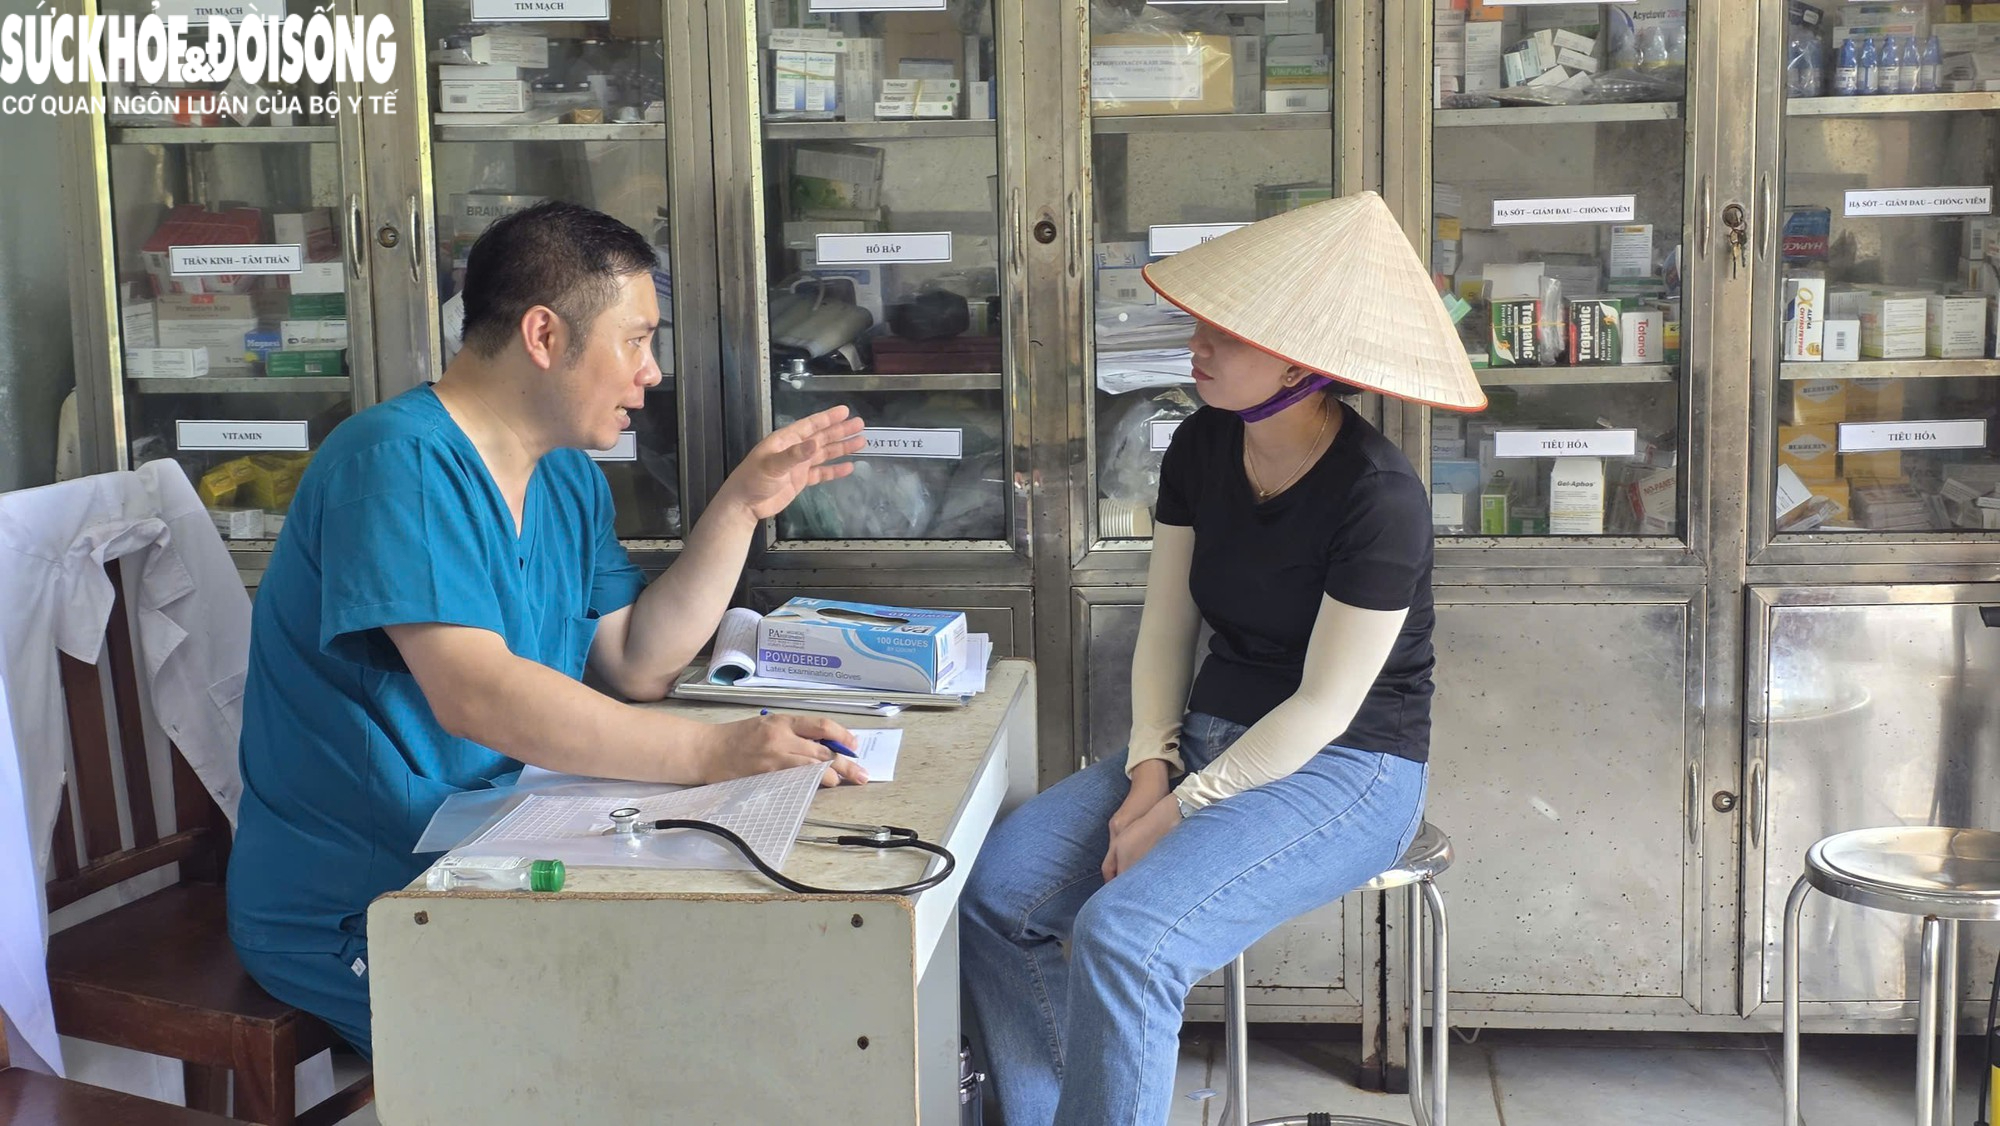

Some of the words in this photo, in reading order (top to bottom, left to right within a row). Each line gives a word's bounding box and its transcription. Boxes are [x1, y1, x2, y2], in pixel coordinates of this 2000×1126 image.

[195, 7, 213, 16] TIM
[515, 2, 532, 10] TIM
[535, 2, 565, 11] MẠCH
[1849, 201, 1861, 210] HẠ
[1497, 209, 1508, 218] HẠ
[210, 257, 233, 265] KINH
[241, 254, 262, 264] TÂM
[1519, 303, 1535, 359] Trapavic
[1578, 305, 1594, 361] Trapavic
[222, 432, 262, 440] VITAMIN
[1888, 431, 1911, 441] TIÊU
[1914, 431, 1937, 441] HÓA
[902, 439, 910, 448] Y
[1541, 439, 1564, 449] TIÊU
[1567, 439, 1588, 449] HÓA
[876, 636, 891, 646] 100
[893, 638, 929, 649] GLOVES
[765, 650, 830, 667] POWDERED
[765, 665, 786, 674] Latex
[788, 666, 834, 678] Examination
[835, 671, 863, 681] Gloves
